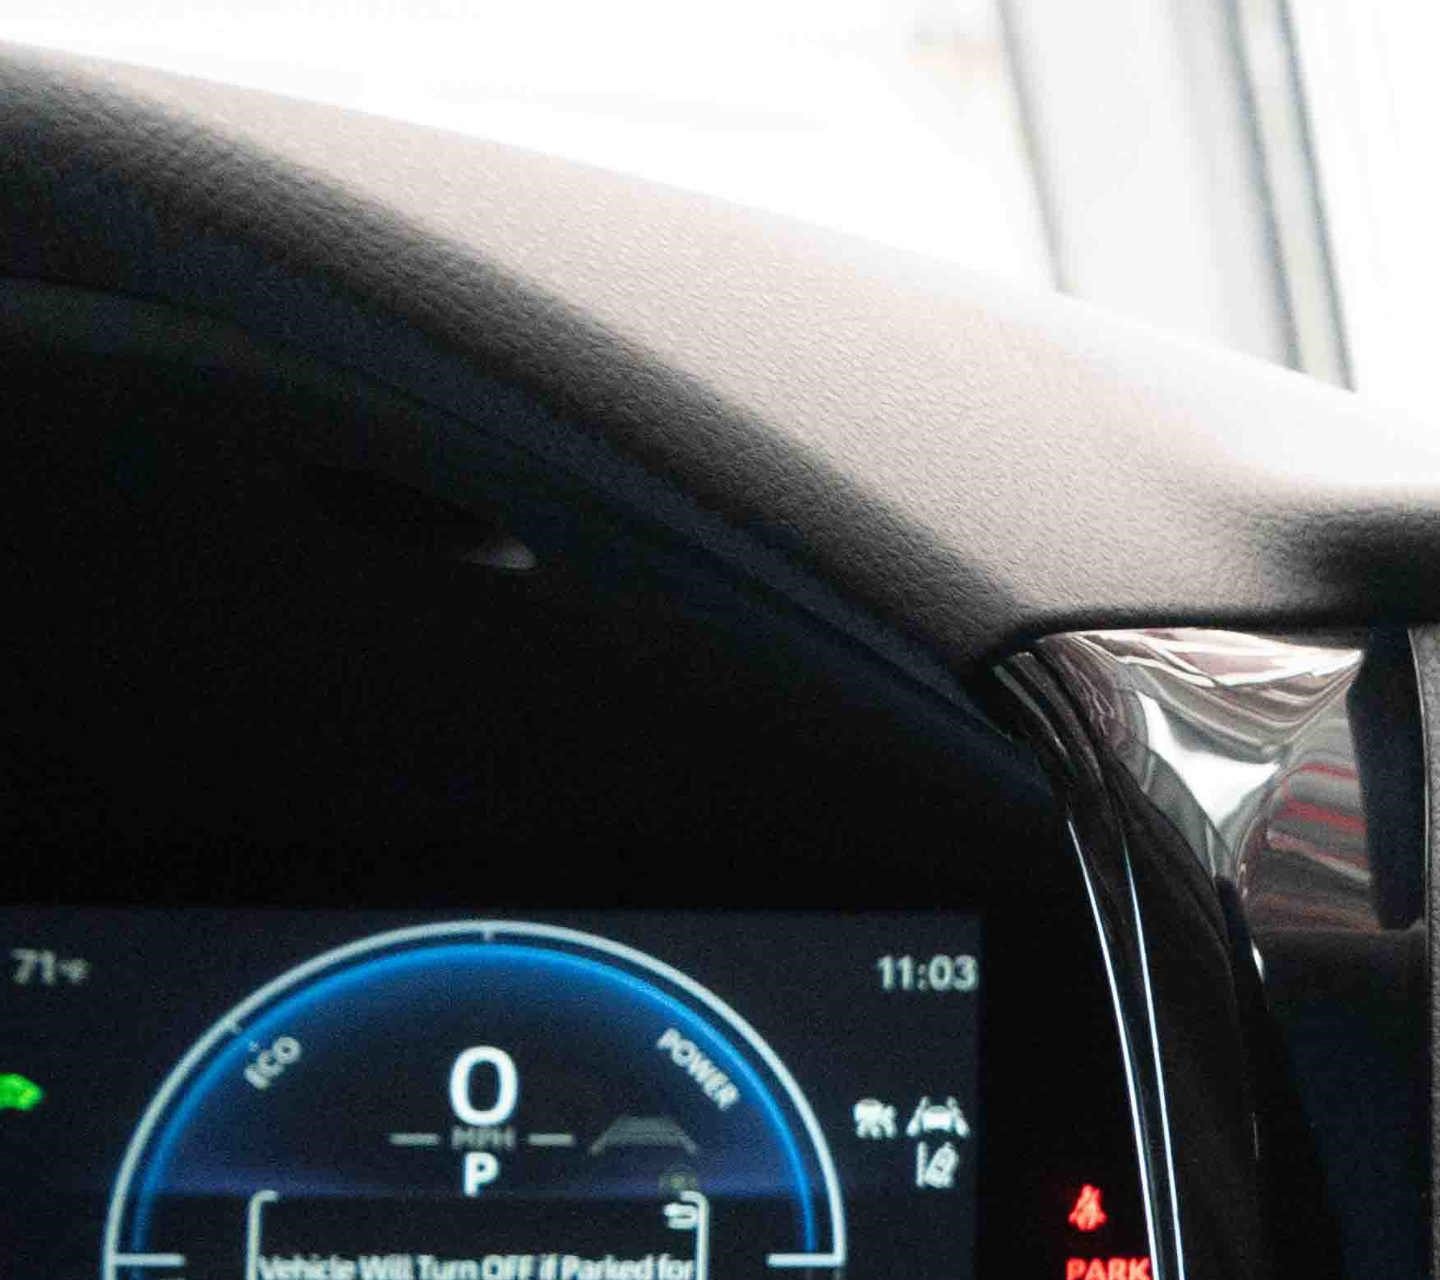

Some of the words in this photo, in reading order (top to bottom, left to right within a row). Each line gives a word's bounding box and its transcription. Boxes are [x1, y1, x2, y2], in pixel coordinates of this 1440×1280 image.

[876, 955, 979, 991] 11:03
[245, 1036, 300, 1090] ECO
[450, 1046, 519, 1127] 0
[655, 1028, 741, 1111] POWER
[464, 1152, 500, 1198] P
